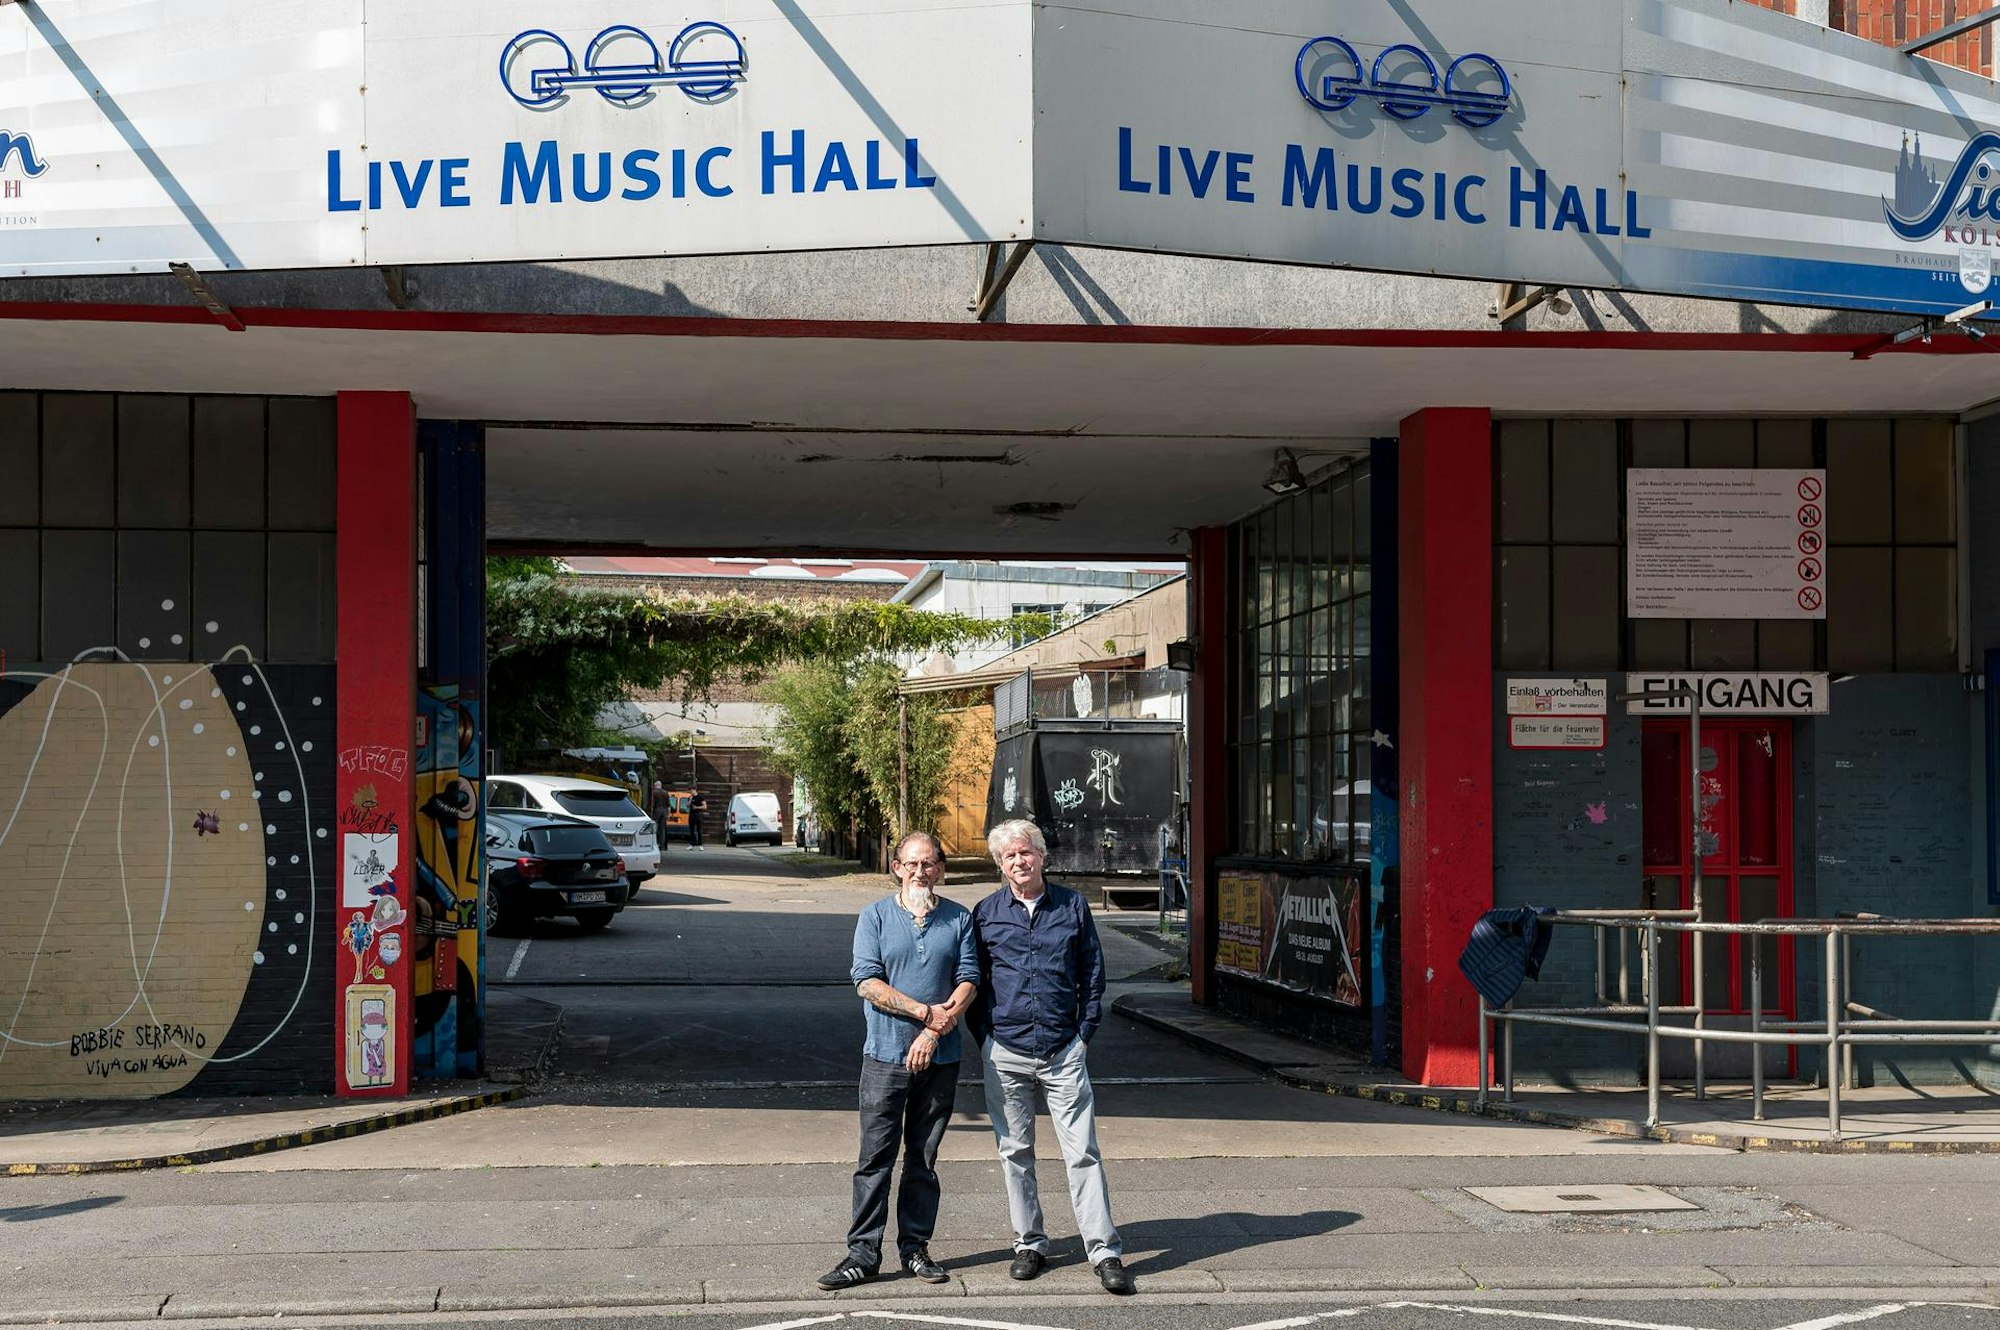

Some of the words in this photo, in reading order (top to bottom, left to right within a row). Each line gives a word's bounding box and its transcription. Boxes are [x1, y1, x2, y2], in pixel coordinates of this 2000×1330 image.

[1932, 271, 1957, 283] SEIT
[1509, 686, 1540, 697] Einlaß
[1544, 686, 1604, 697] vorbehalten
[1643, 677, 1813, 708] EINGANG
[1515, 724, 1537, 733] Fläche
[1539, 724, 1550, 733] für
[1552, 724, 1563, 733] die
[1566, 724, 1600, 734] Feuerwehr
[1312, 936, 1331, 951] ALBUM
[135, 1023, 206, 1049] SERRANO
[152, 1053, 188, 1070] AGUA
